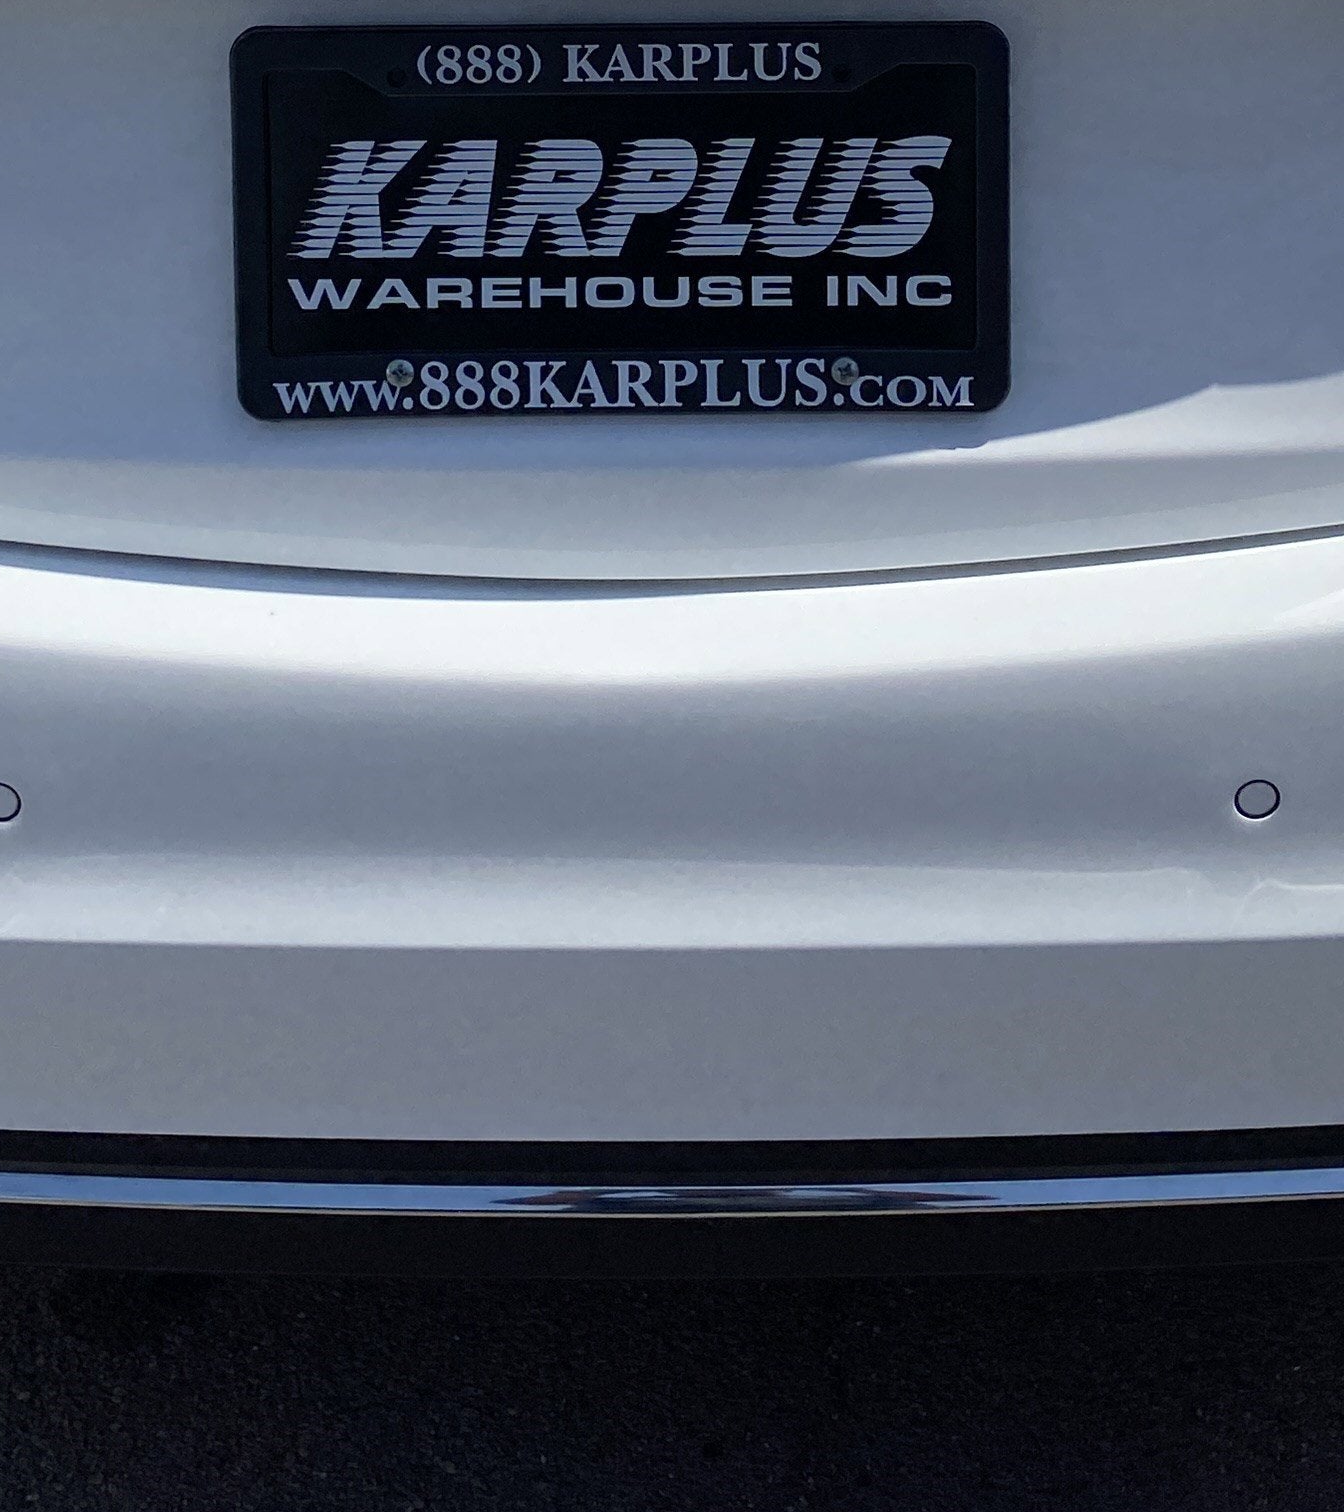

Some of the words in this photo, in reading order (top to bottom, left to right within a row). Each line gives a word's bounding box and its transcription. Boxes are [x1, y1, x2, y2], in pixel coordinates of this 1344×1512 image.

[416, 43, 541, 85] (888)
[562, 42, 822, 83] KARPLUS
[285, 134, 953, 258] KARPLUS
[287, 274, 793, 311] WAREHOUSE
[826, 274, 953, 308] INC
